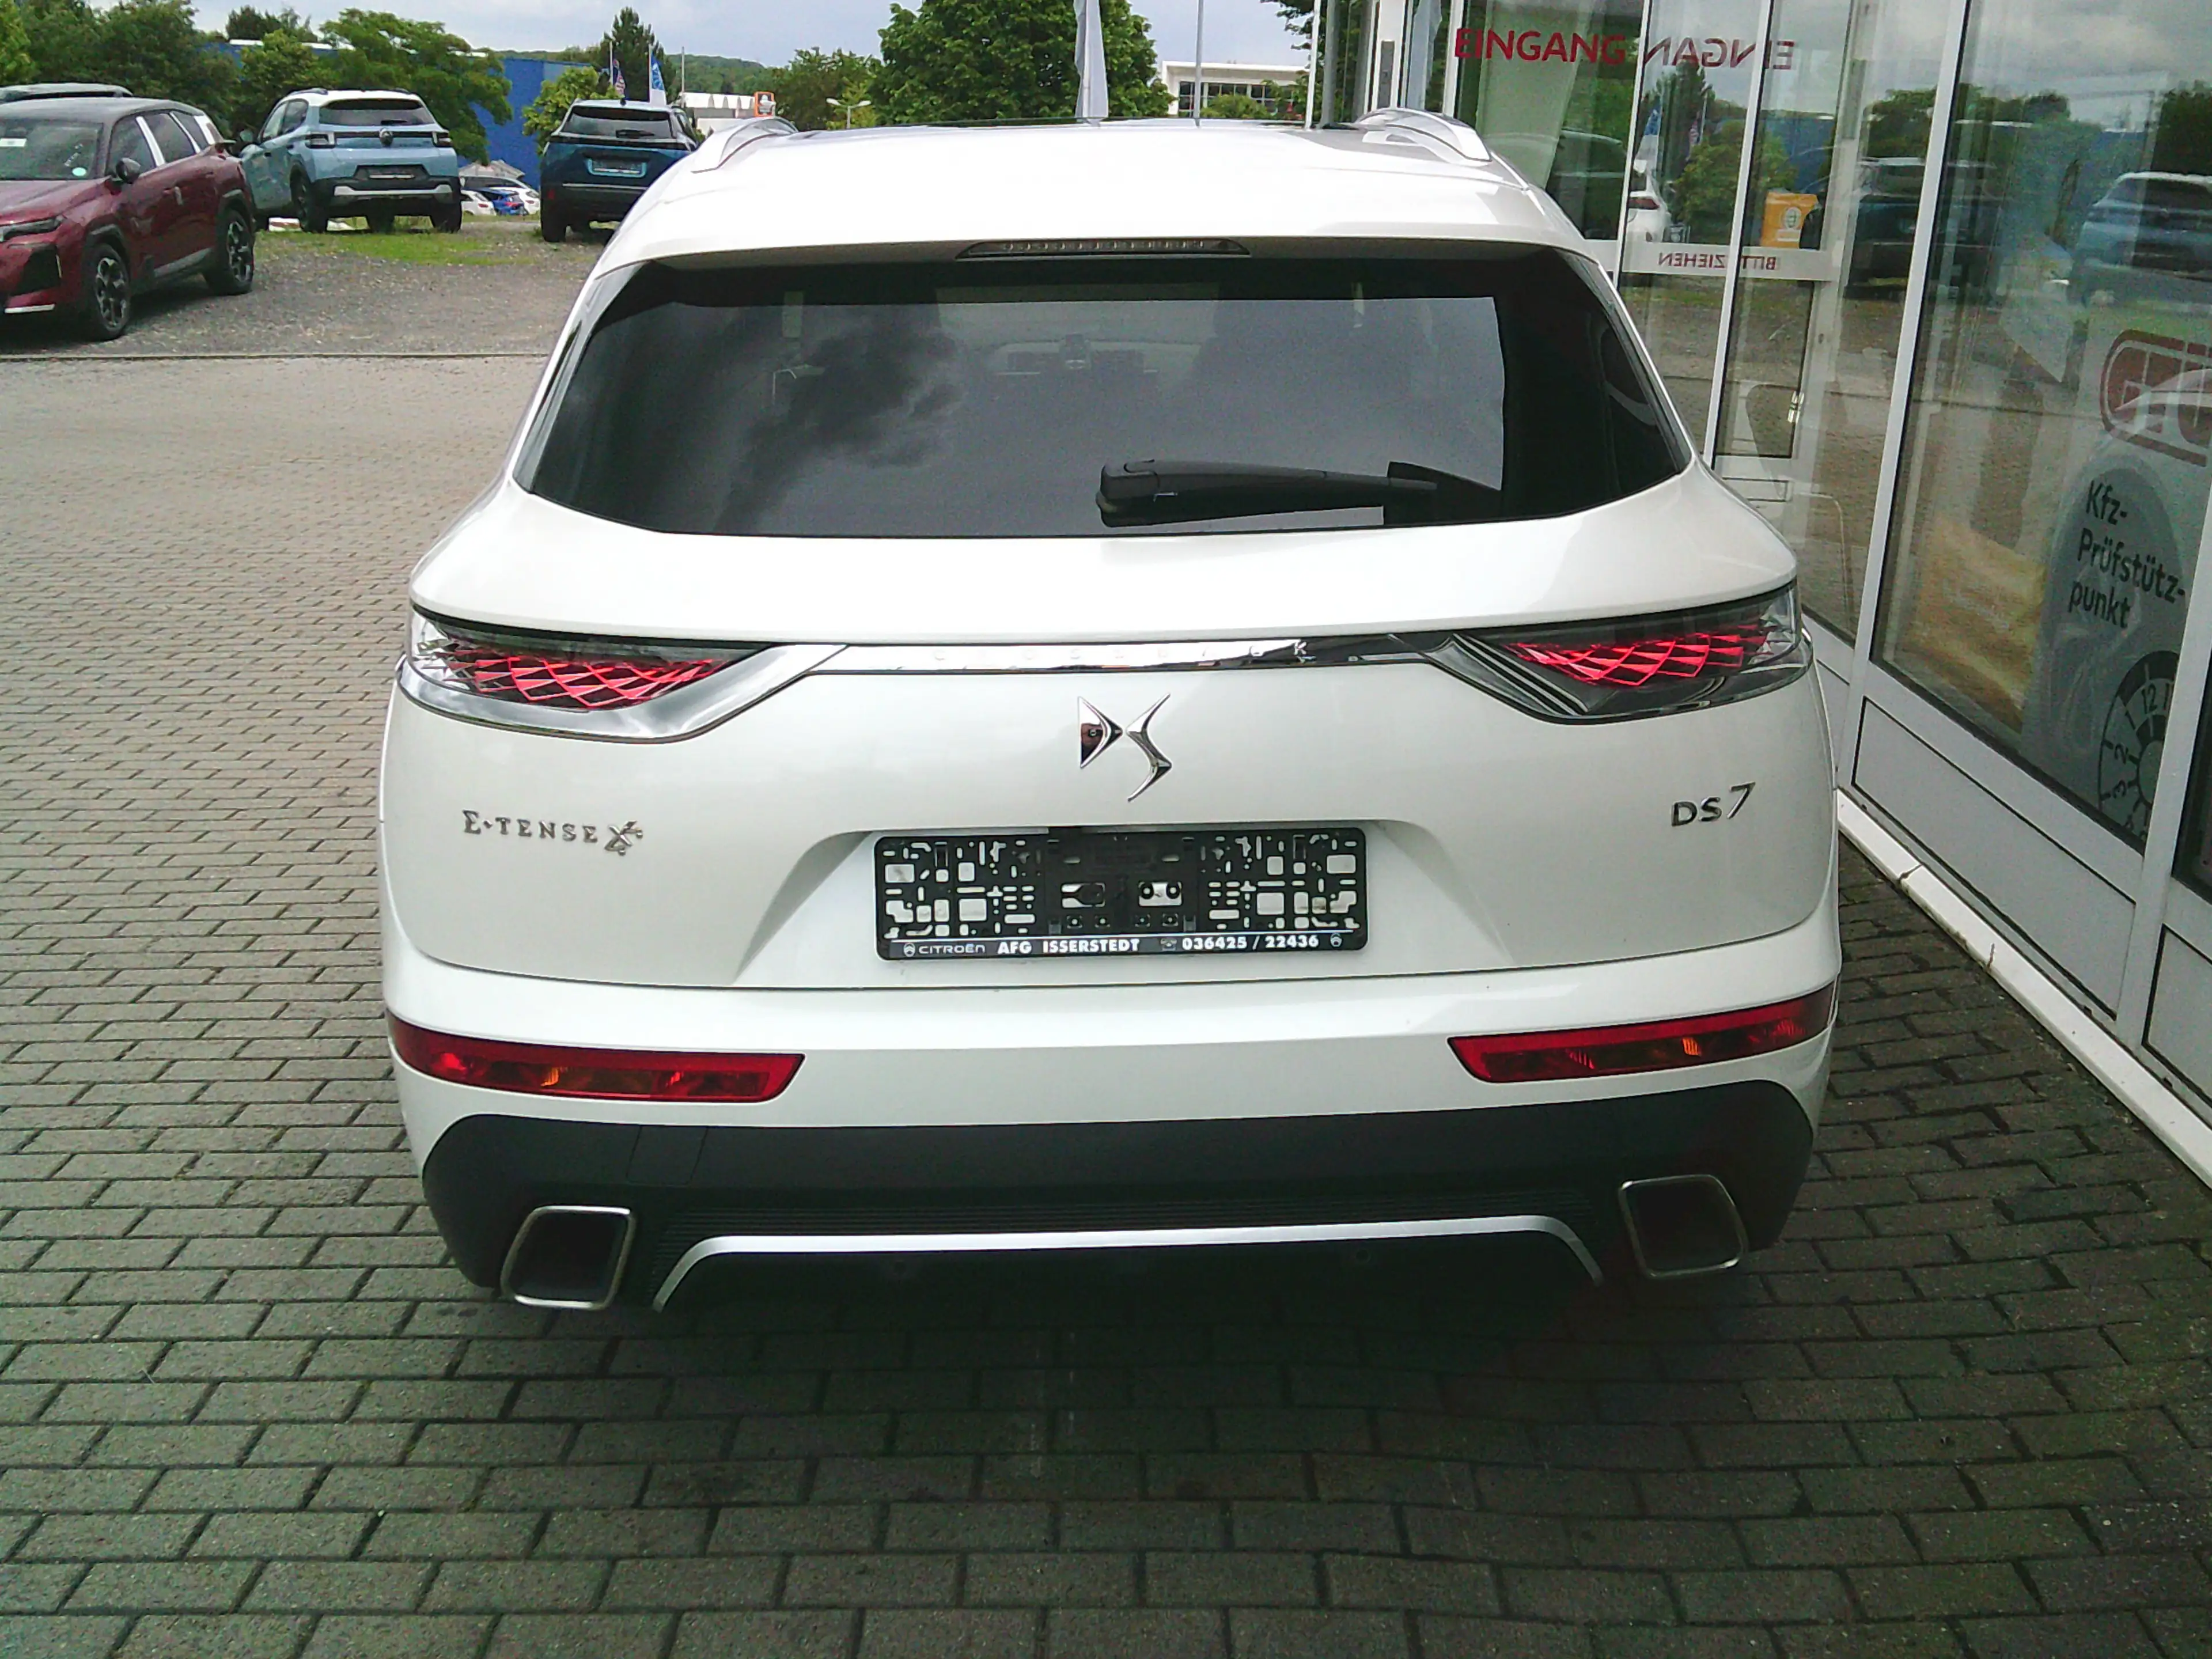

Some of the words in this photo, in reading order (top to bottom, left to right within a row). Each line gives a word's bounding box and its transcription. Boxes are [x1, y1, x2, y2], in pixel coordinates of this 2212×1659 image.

[1454, 27, 1626, 65] EINGANG
[2085, 480, 2128, 525] Kfz-
[2077, 527, 2186, 604] Prüfstütz-
[2067, 580, 2131, 628] punkt
[997, 940, 1033, 955] AFG
[1042, 938, 1141, 954] ISSERSTEDT
[1181, 935, 1248, 950] 036425
[1251, 935, 1260, 951] /
[1264, 934, 1320, 949] 22436
